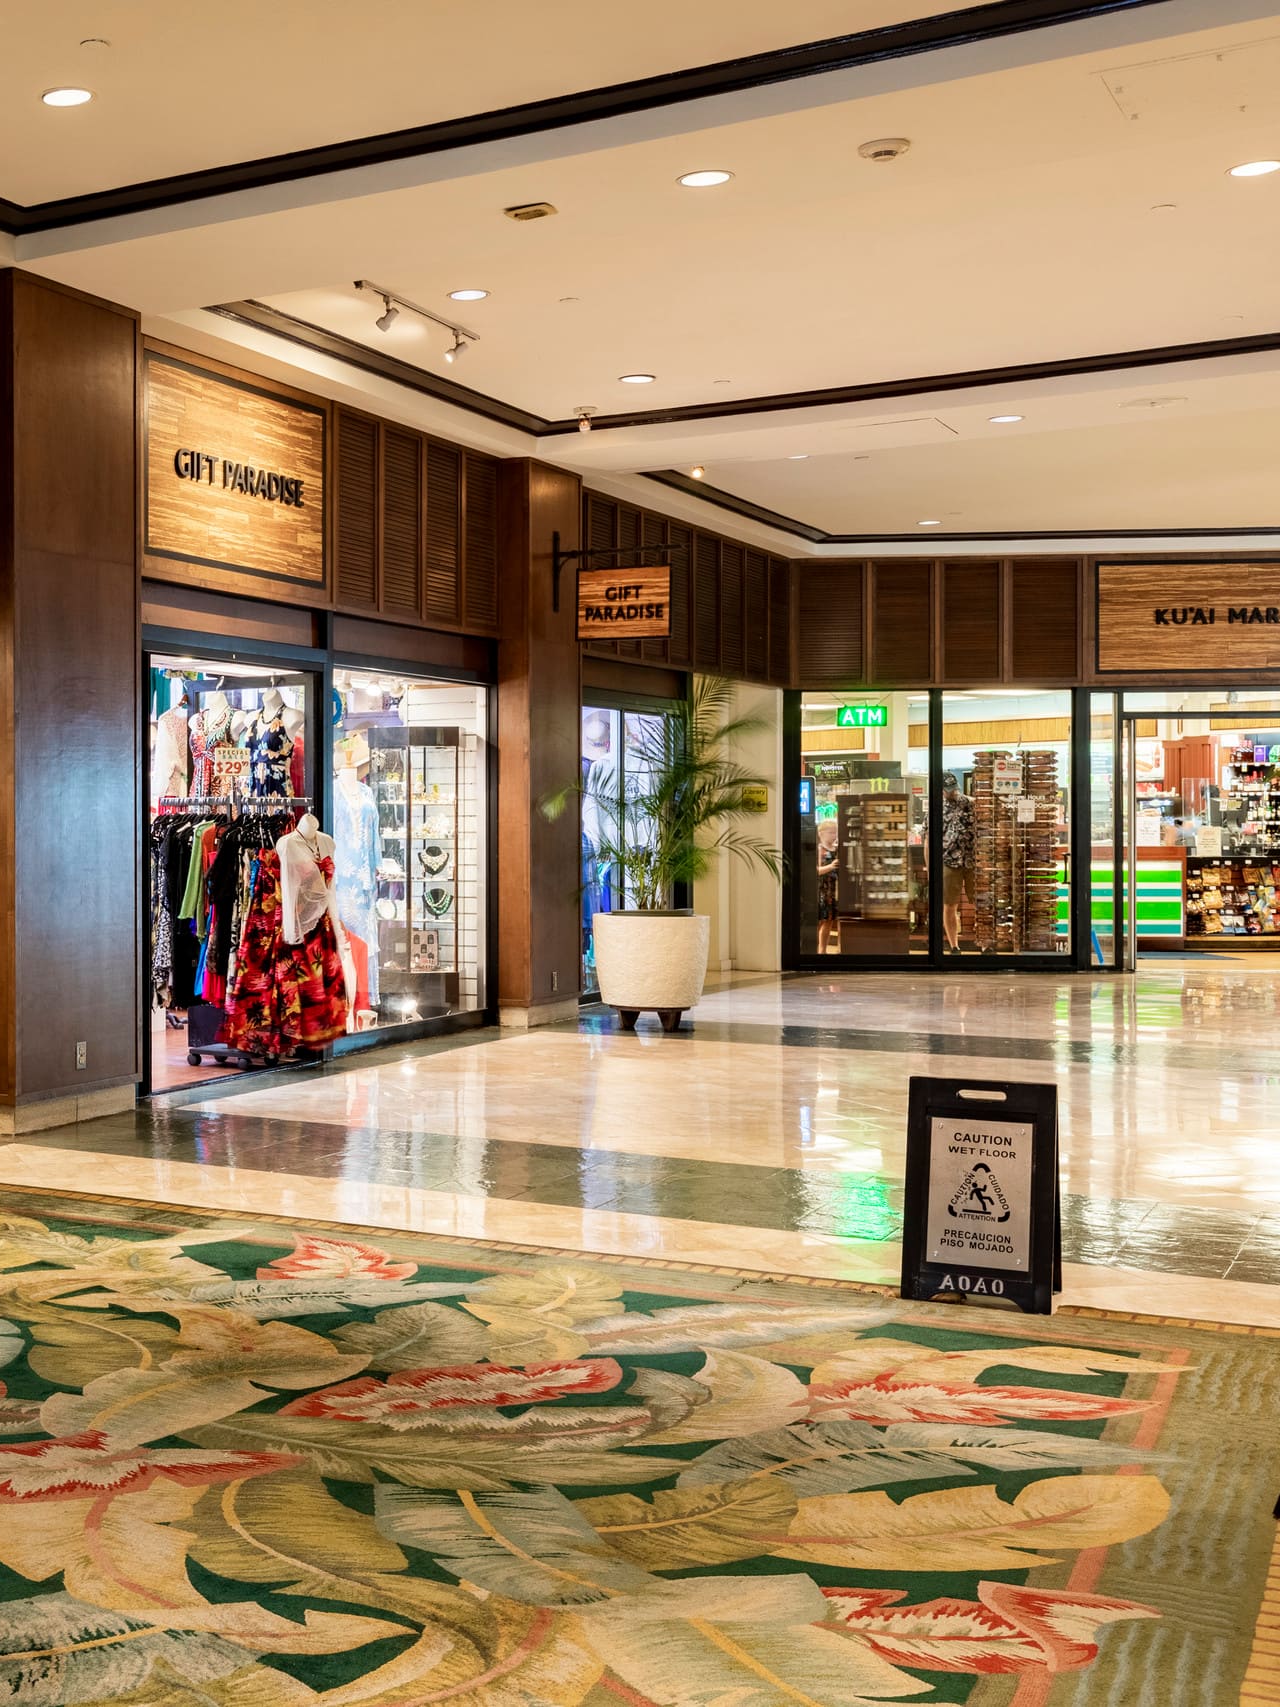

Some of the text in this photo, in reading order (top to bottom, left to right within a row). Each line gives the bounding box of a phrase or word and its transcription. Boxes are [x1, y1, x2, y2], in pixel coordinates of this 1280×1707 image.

[174, 448, 305, 508] GIFT PARADISE
[605, 585, 642, 601] GIFT
[585, 603, 664, 621] PARADISE
[842, 709, 882, 725] ATM
[953, 1132, 1013, 1147] CAUTION
[948, 1145, 1017, 1159] WET FLOOR
[950, 1172, 976, 1205] CAUTION
[988, 1174, 1010, 1211] CUIDADO
[958, 1213, 996, 1223] ATTENTION
[943, 1229, 1011, 1244] PRECAUCION
[940, 1238, 1014, 1254] PISO MOJADO
